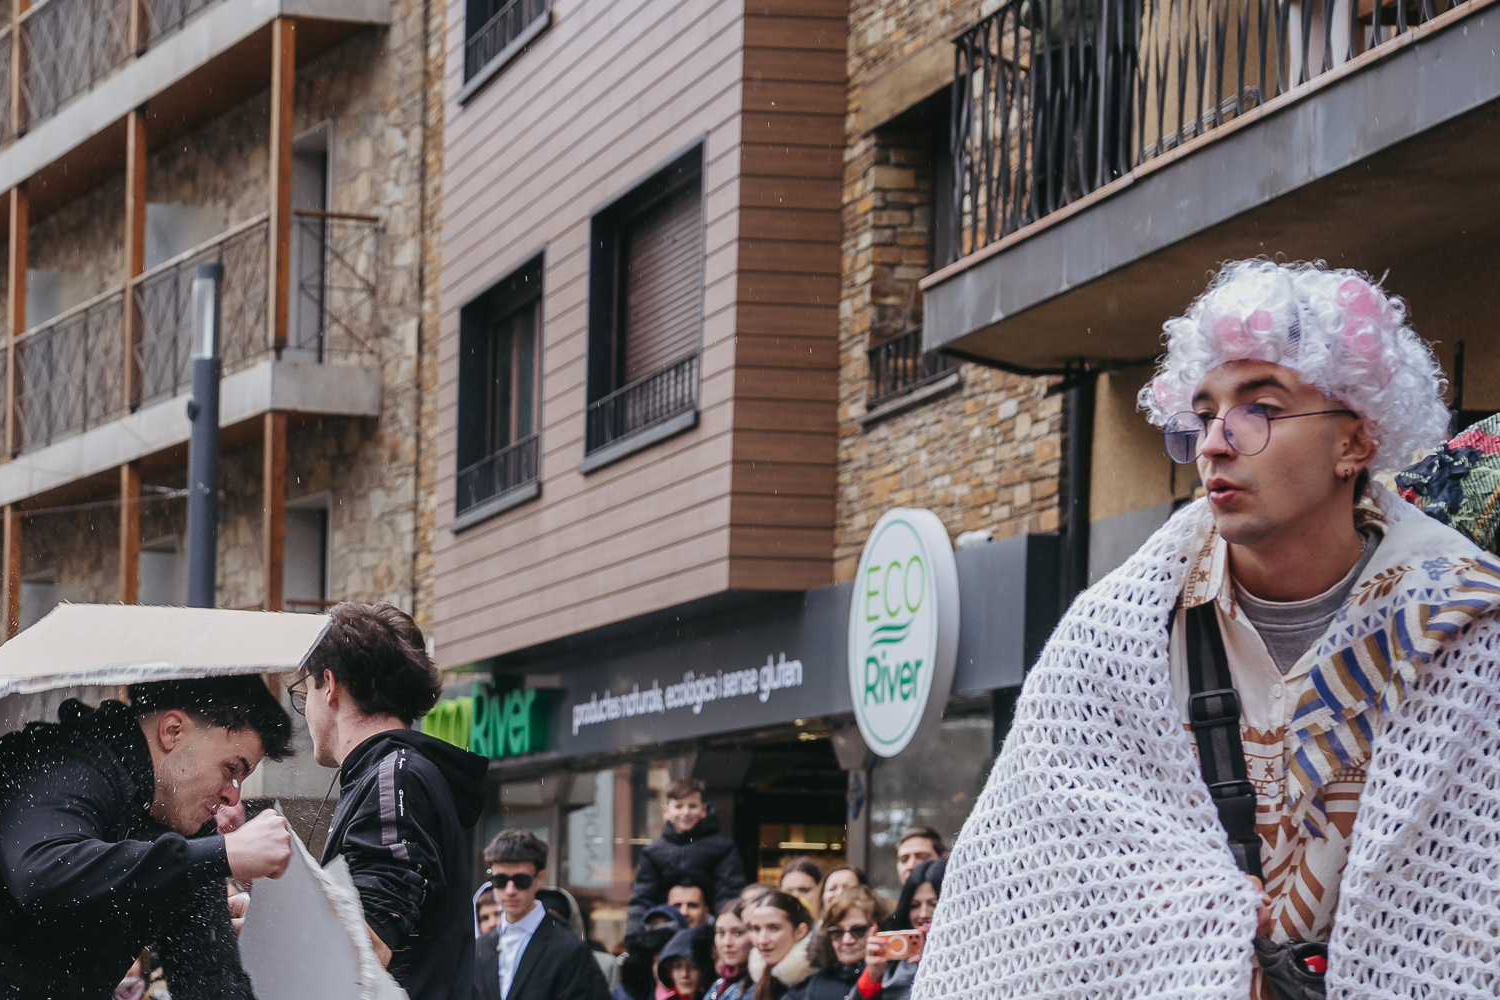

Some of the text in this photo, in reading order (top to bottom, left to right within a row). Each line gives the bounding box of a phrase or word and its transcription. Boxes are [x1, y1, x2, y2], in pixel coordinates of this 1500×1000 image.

[866, 555, 926, 622] ECO
[572, 690, 620, 736] productes
[722, 667, 758, 699] sense
[759, 651, 803, 703] gluten
[864, 651, 924, 706] River
